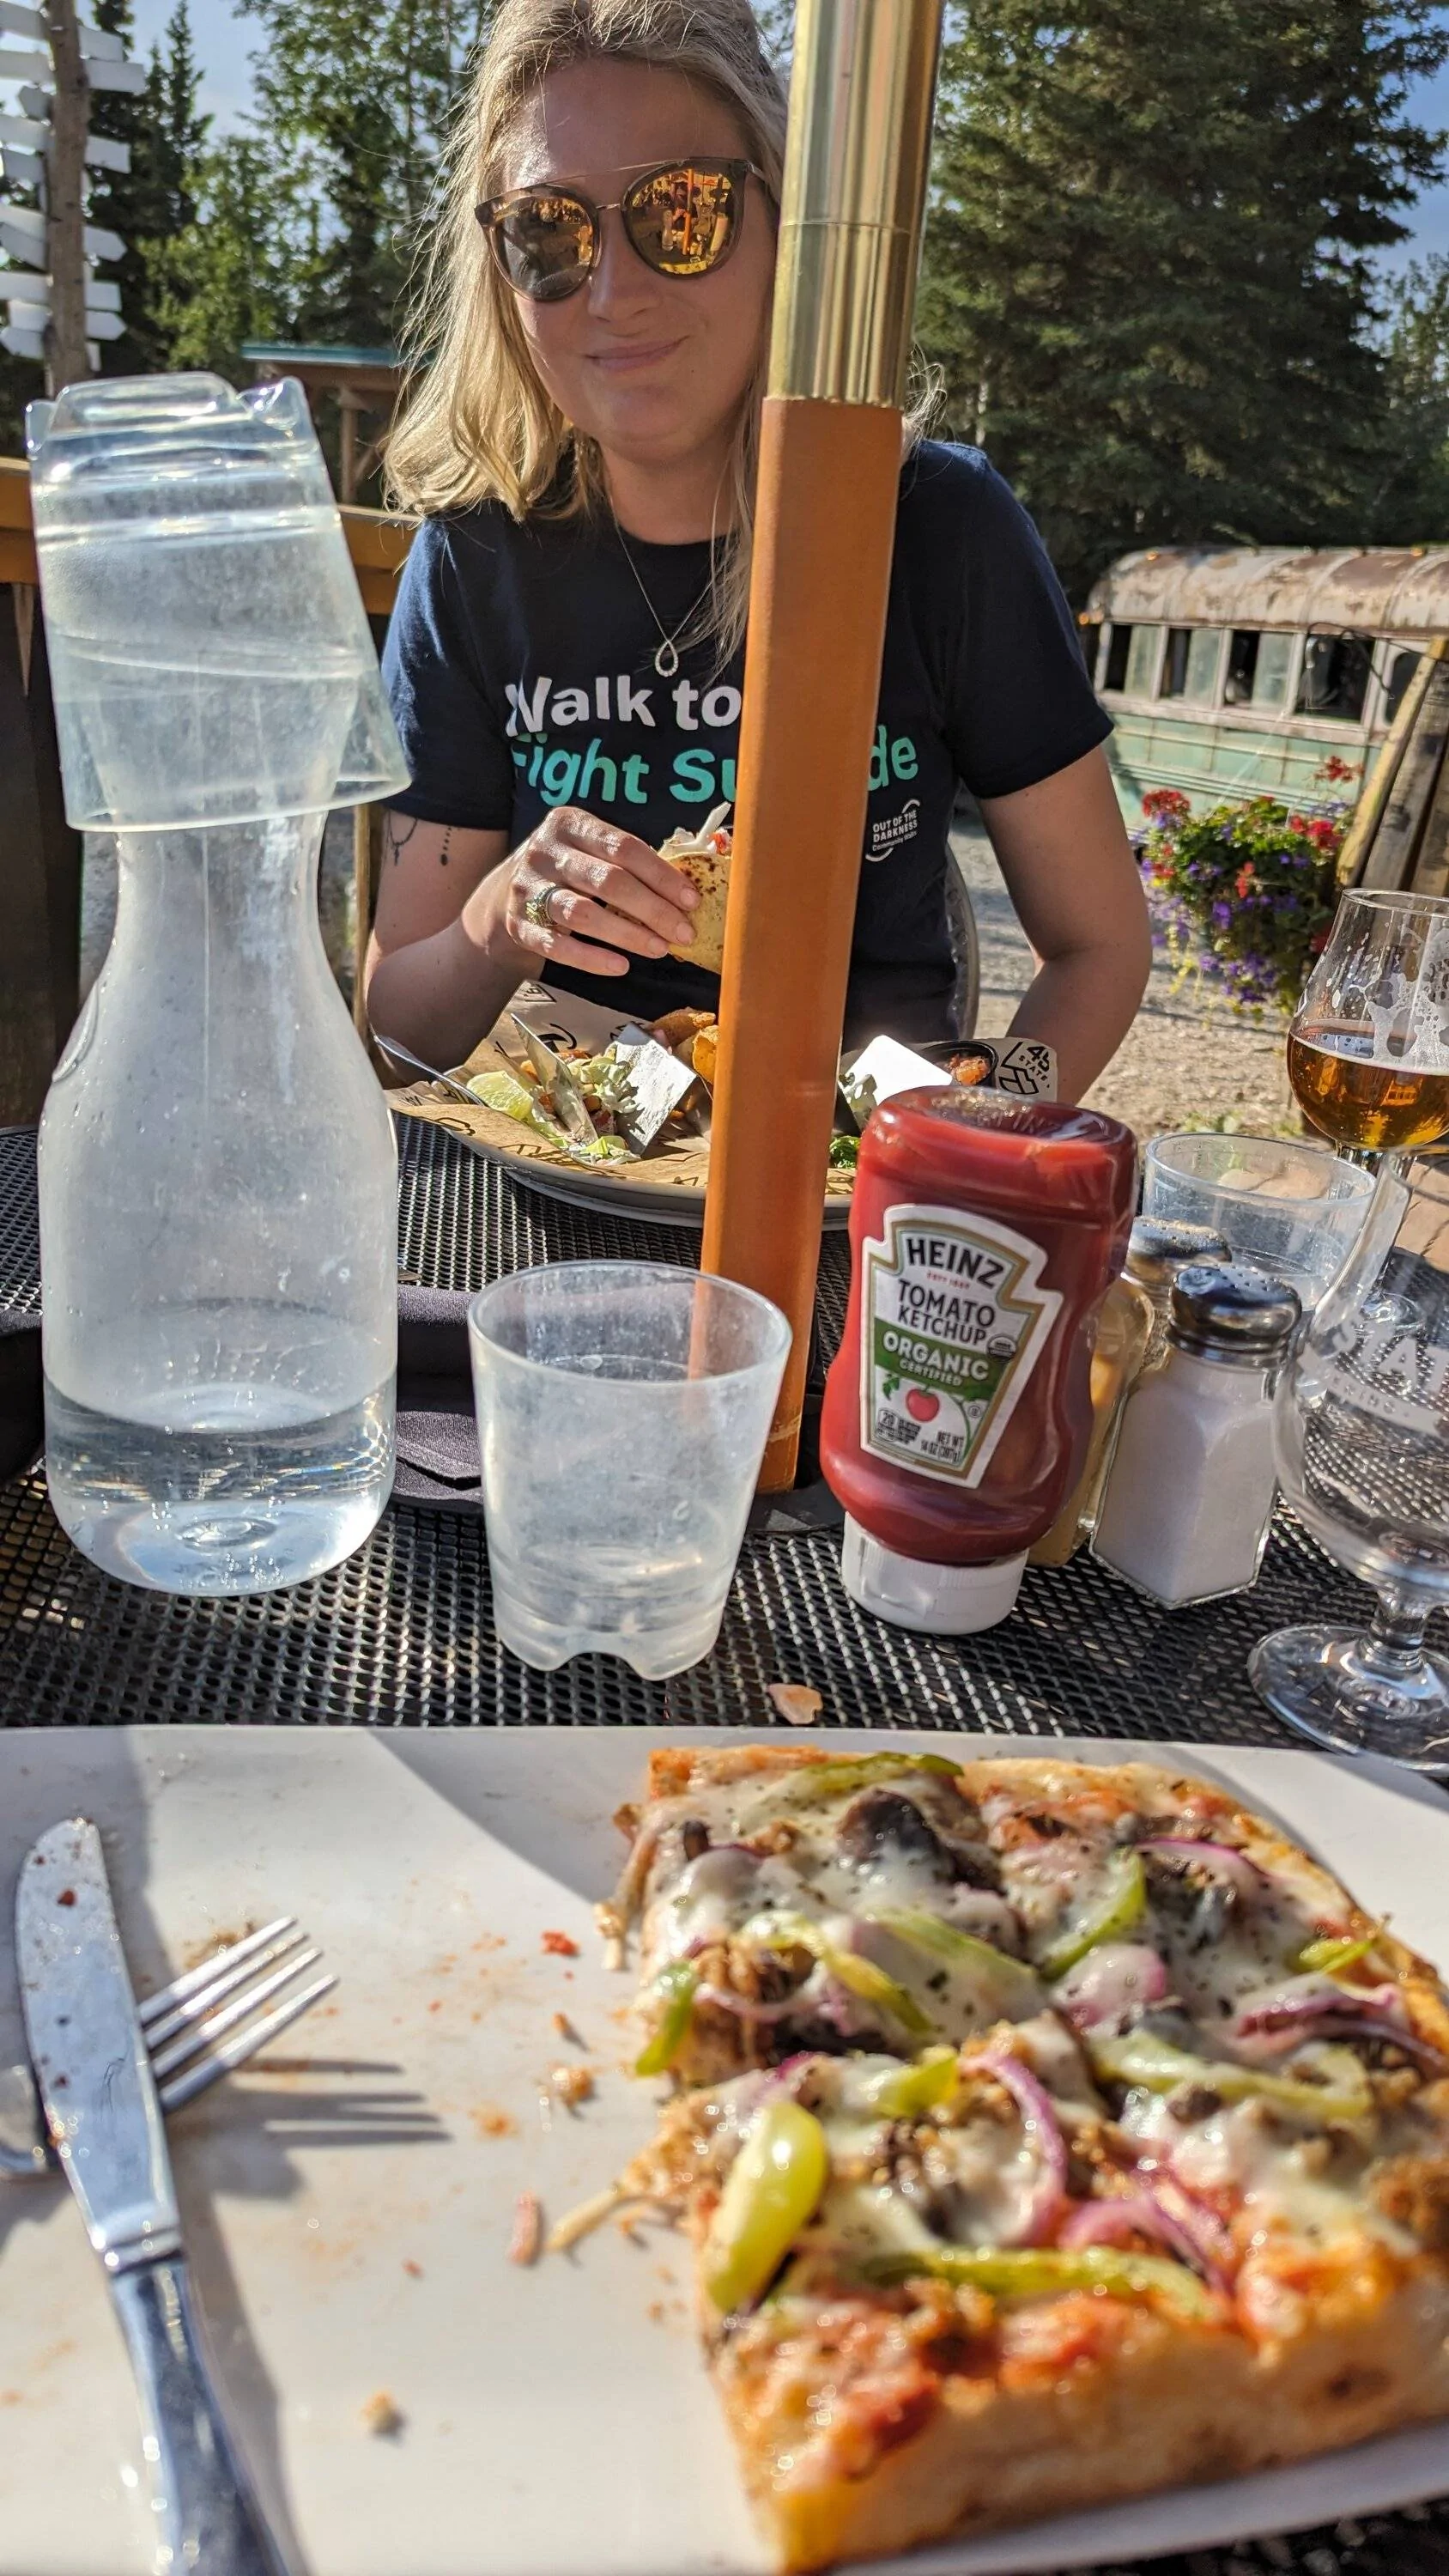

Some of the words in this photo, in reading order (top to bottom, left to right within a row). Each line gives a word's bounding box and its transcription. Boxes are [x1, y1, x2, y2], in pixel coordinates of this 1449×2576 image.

[672, 680, 742, 730] to
[873, 820, 891, 833] OUT
[893, 816, 902, 827] OF
[904, 810, 917, 822] THE
[873, 820, 918, 842] DARKNESS
[1019, 1055, 1047, 1081] STATE
[906, 1238, 1003, 1289] HEINZ
[899, 1279, 995, 1327] TOMATO
[899, 1305, 986, 1346] KETCHUP
[883, 1331, 989, 1380] ORGANIC
[900, 1359, 962, 1386] CERTIFIED
[937, 1431, 951, 1445] NET
